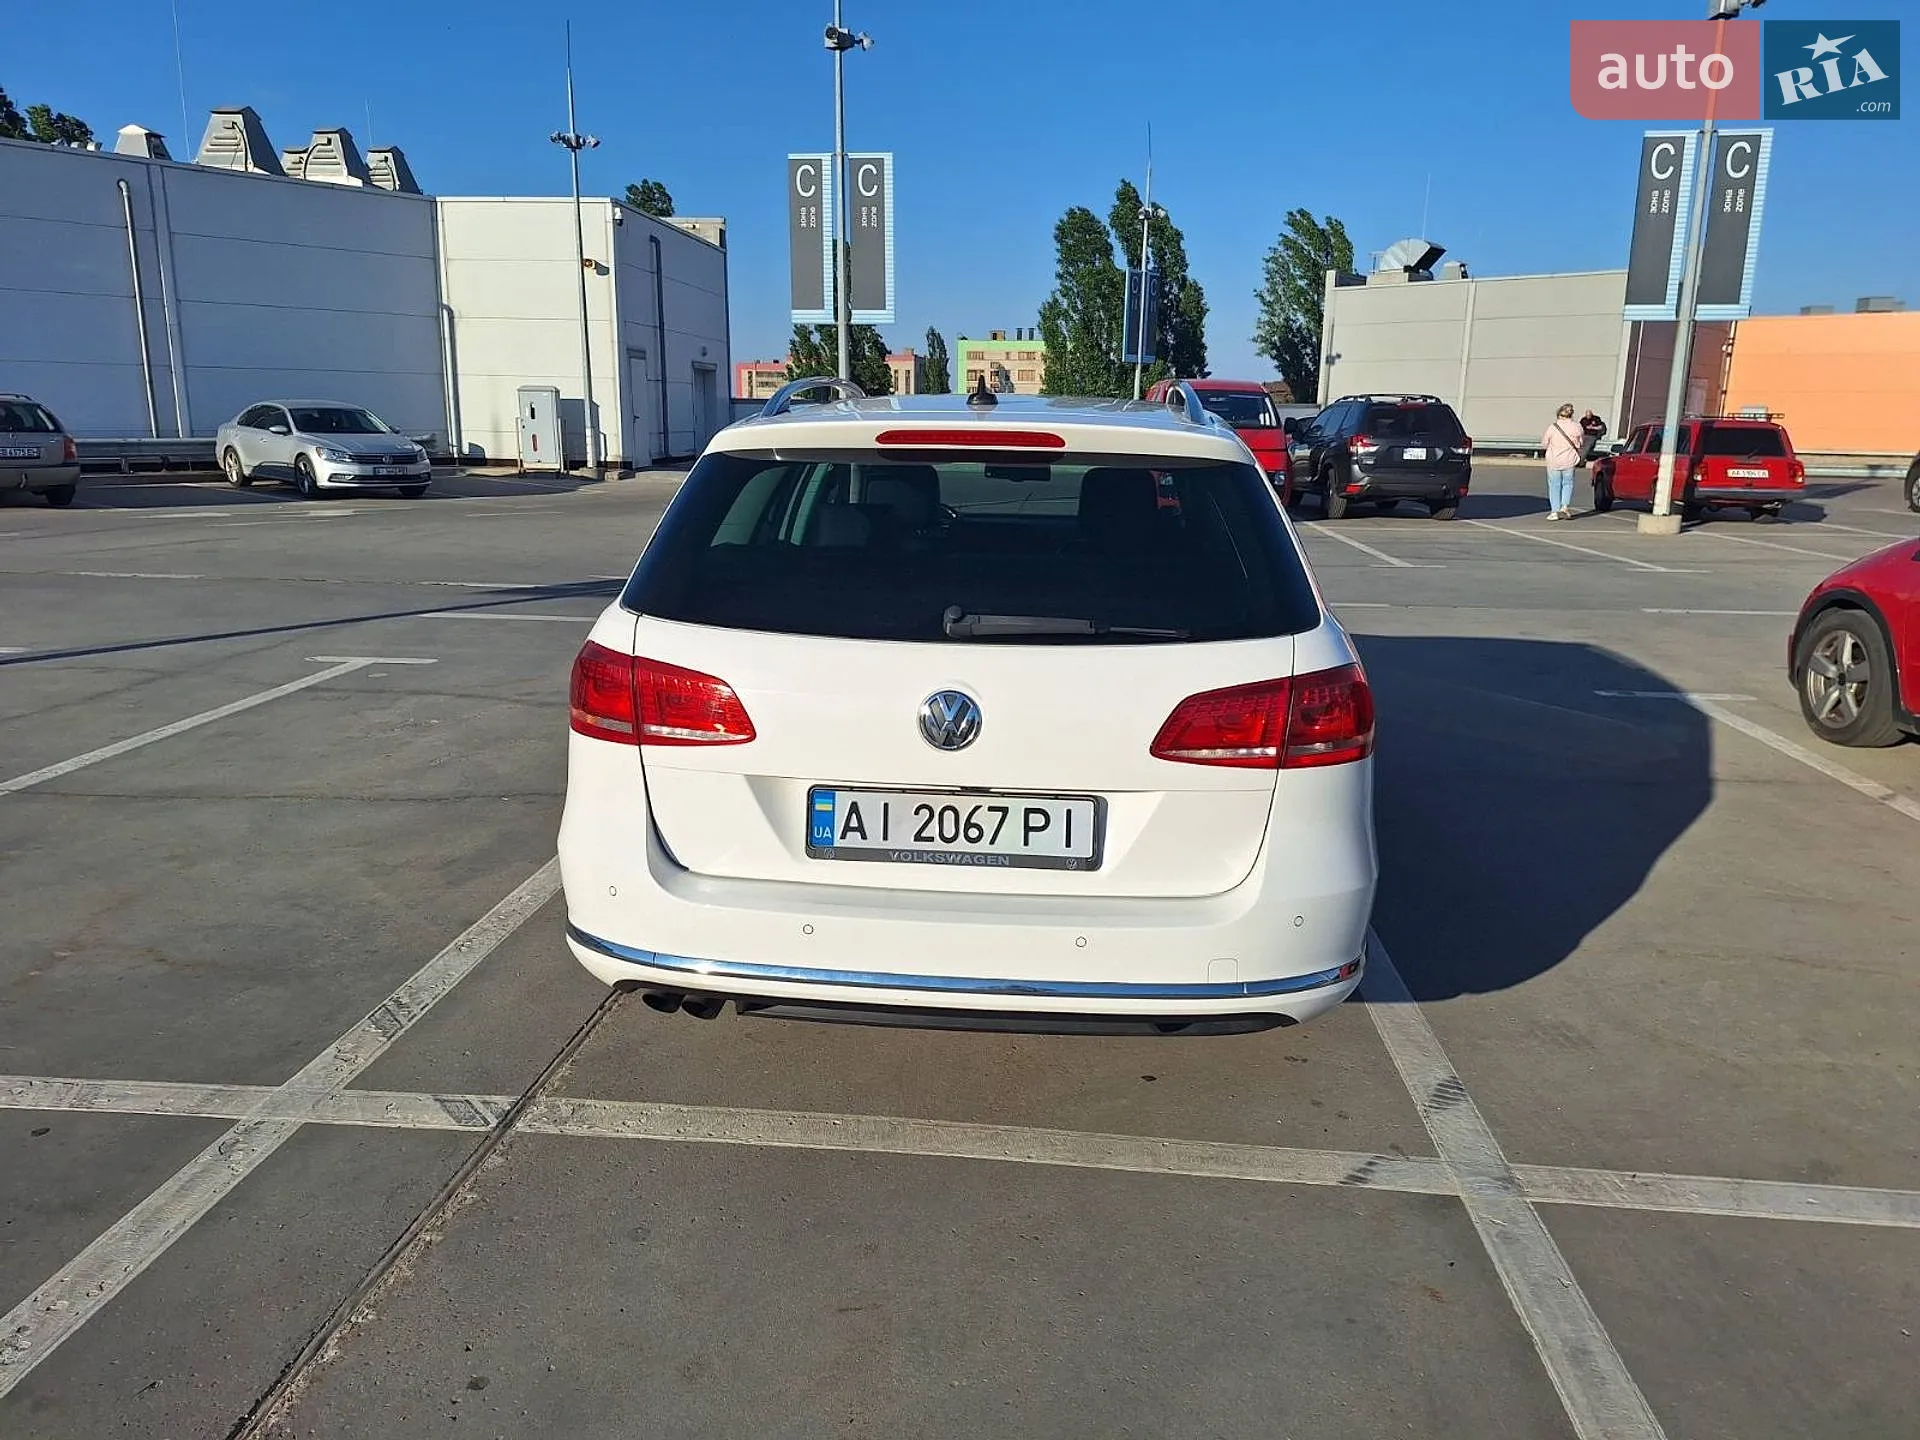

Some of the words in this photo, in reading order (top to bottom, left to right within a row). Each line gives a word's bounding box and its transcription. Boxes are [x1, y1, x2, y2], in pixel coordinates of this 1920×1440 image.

[1651, 142, 1676, 180] C
[1726, 141, 1752, 179] C
[796, 164, 816, 197] C
[857, 164, 878, 197] C
[1661, 189, 1671, 214] zone
[1735, 188, 1745, 213] zone
[813, 826, 833, 840] UA
[839, 801, 889, 841] AI
[913, 803, 1010, 845] 2067
[1022, 807, 1072, 848] PI
[889, 851, 1009, 865] VOLKSWAGEN
